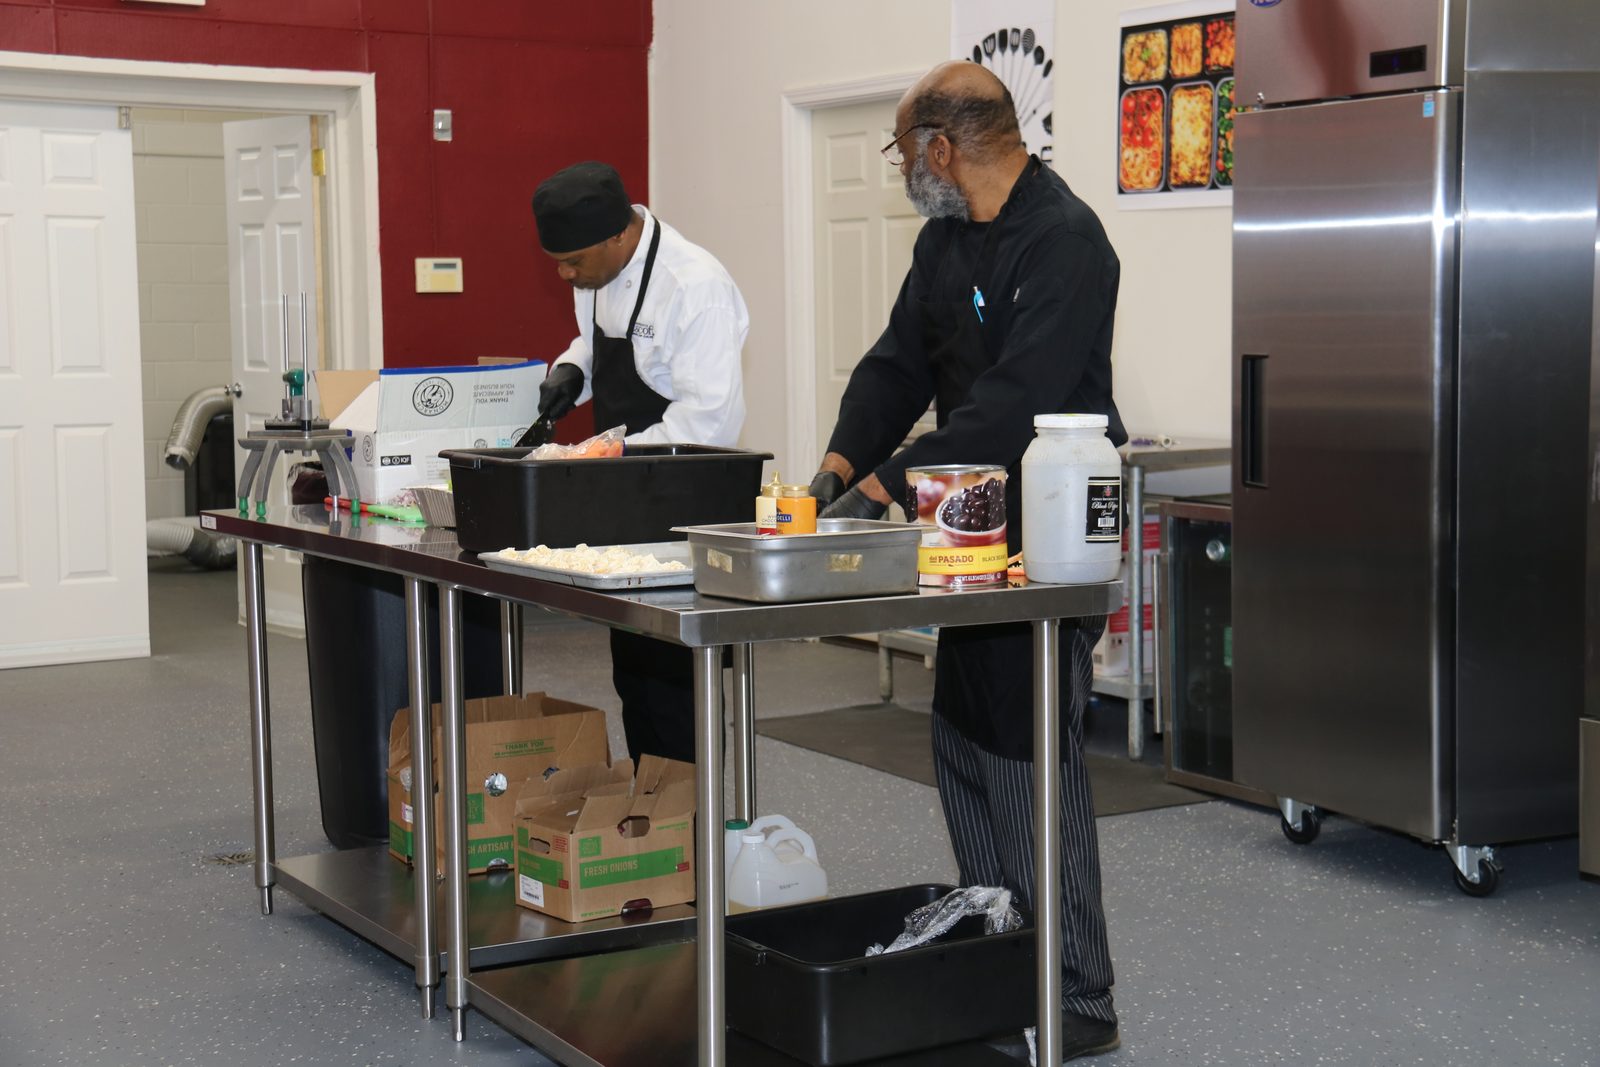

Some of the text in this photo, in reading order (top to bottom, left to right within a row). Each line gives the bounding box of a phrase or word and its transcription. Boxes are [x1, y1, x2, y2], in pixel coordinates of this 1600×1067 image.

[416, 400, 449, 415] MONARCH
[938, 555, 974, 563] PASADO
[505, 742, 528, 750] THANK
[478, 841, 509, 853] ARTISAN
[584, 860, 638, 877] FRESH ONIONS
